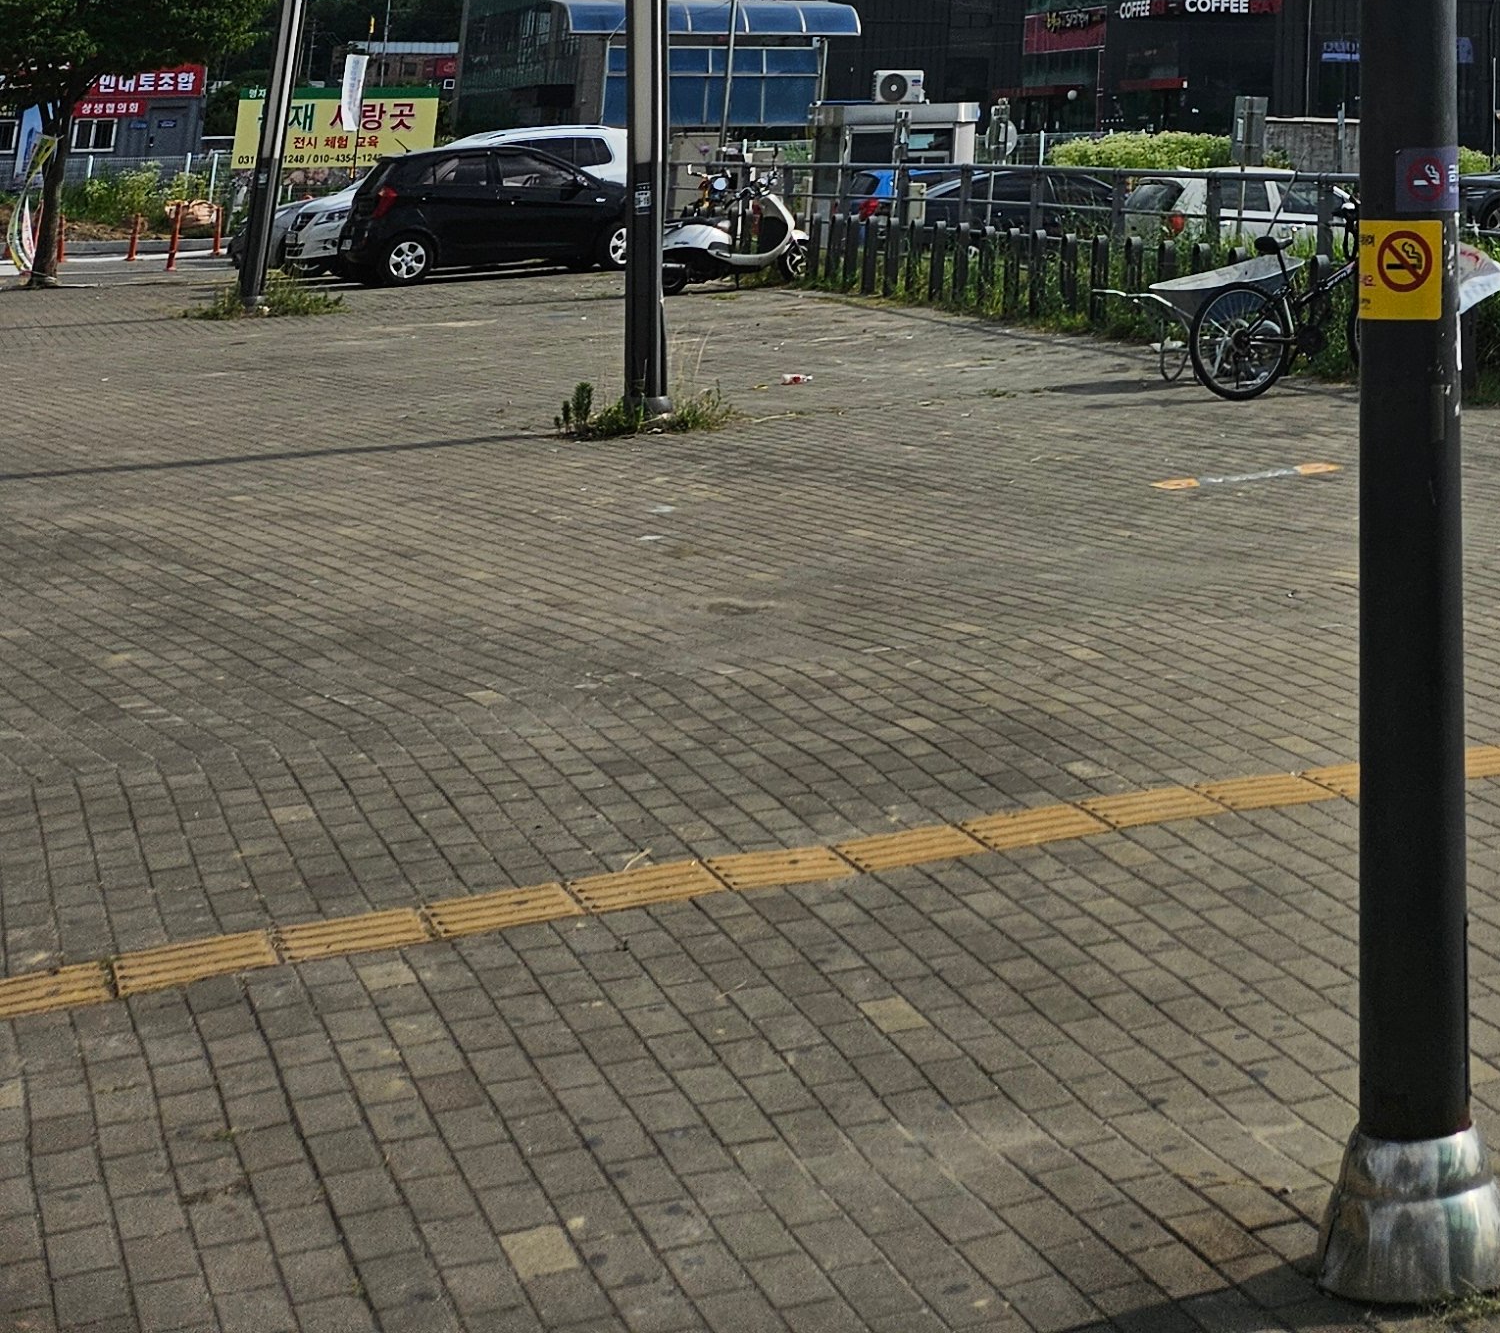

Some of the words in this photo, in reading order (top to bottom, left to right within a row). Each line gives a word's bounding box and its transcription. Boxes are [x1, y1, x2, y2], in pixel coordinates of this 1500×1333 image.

[1119, 0, 1151, 19] COFFEE
[82, 102, 139, 114] 상생협의회
[293, 136, 318, 149] 전시
[324, 136, 348, 149] 체험
